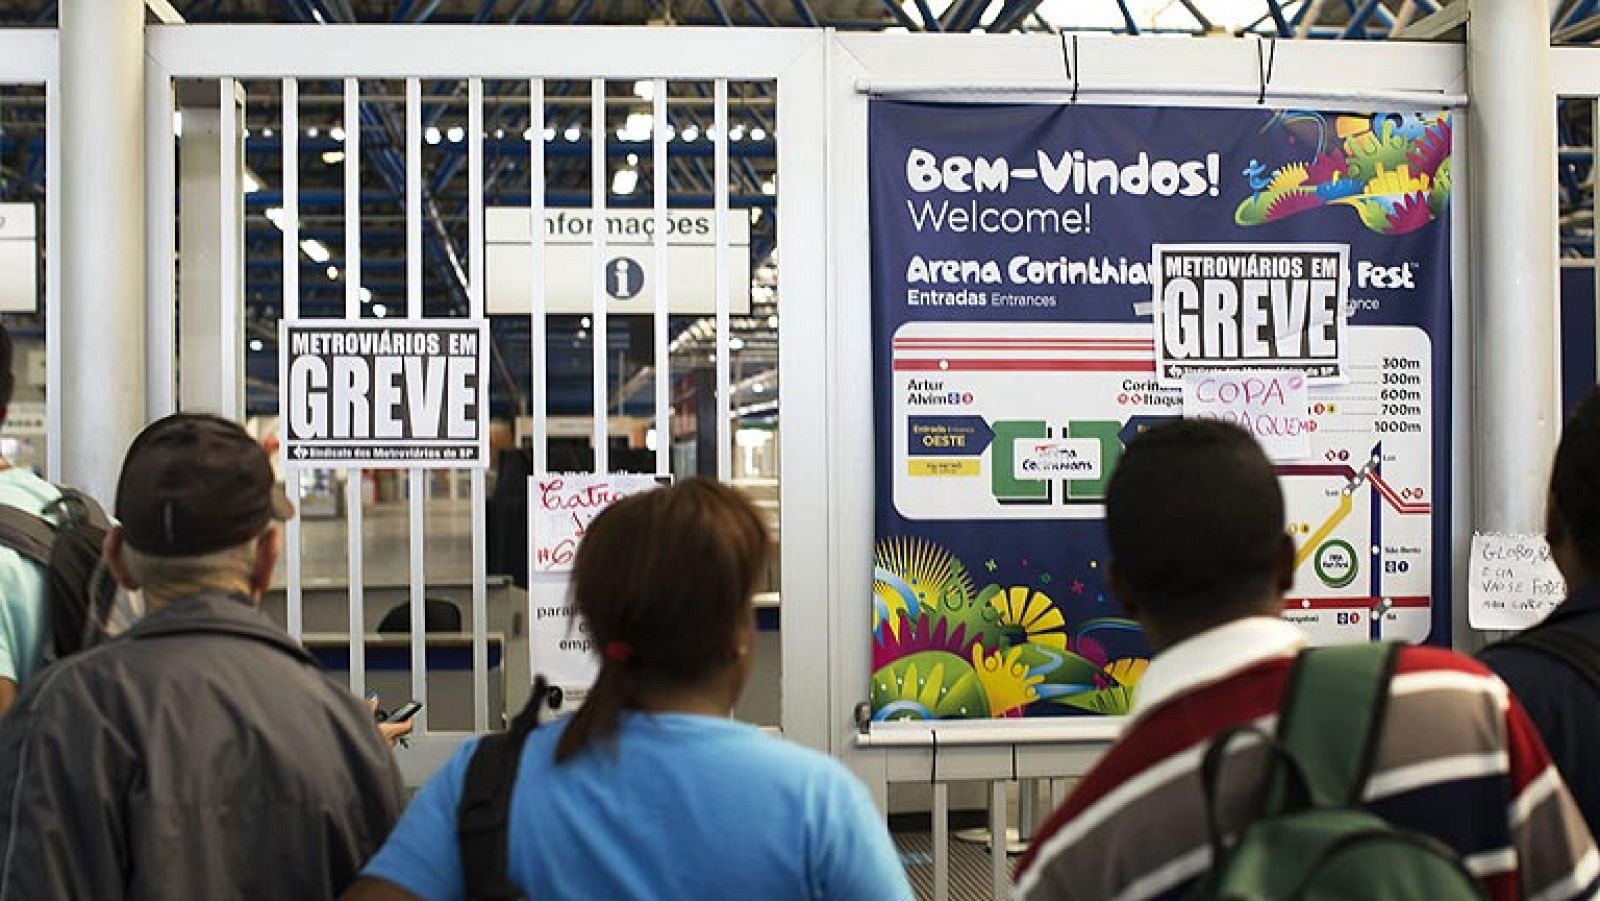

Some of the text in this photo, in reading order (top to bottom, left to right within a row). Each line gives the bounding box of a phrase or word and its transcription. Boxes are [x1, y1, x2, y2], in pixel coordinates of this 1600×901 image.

[908, 200, 1091, 234] Welcome!
[907, 255, 1002, 285] Arena
[1166, 254, 1337, 278] METROVIÁRIOS EM
[908, 289, 987, 306] Entradas
[991, 291, 1057, 307] Entrances
[1164, 277, 1337, 359] GREVE
[291, 329, 476, 355] METROVIÁRIOS EM
[1382, 358, 1420, 370] 300m
[907, 379, 944, 391] Artur
[1382, 373, 1420, 385] 300m
[289, 354, 476, 439] GREVE
[907, 393, 947, 405] Alvim
[1197, 379, 1284, 404] COPA
[1380, 389, 1421, 400] 600m
[1380, 404, 1421, 415] 700m
[1375, 420, 1421, 432] 1000m
[922, 435, 966, 447] OESTE
